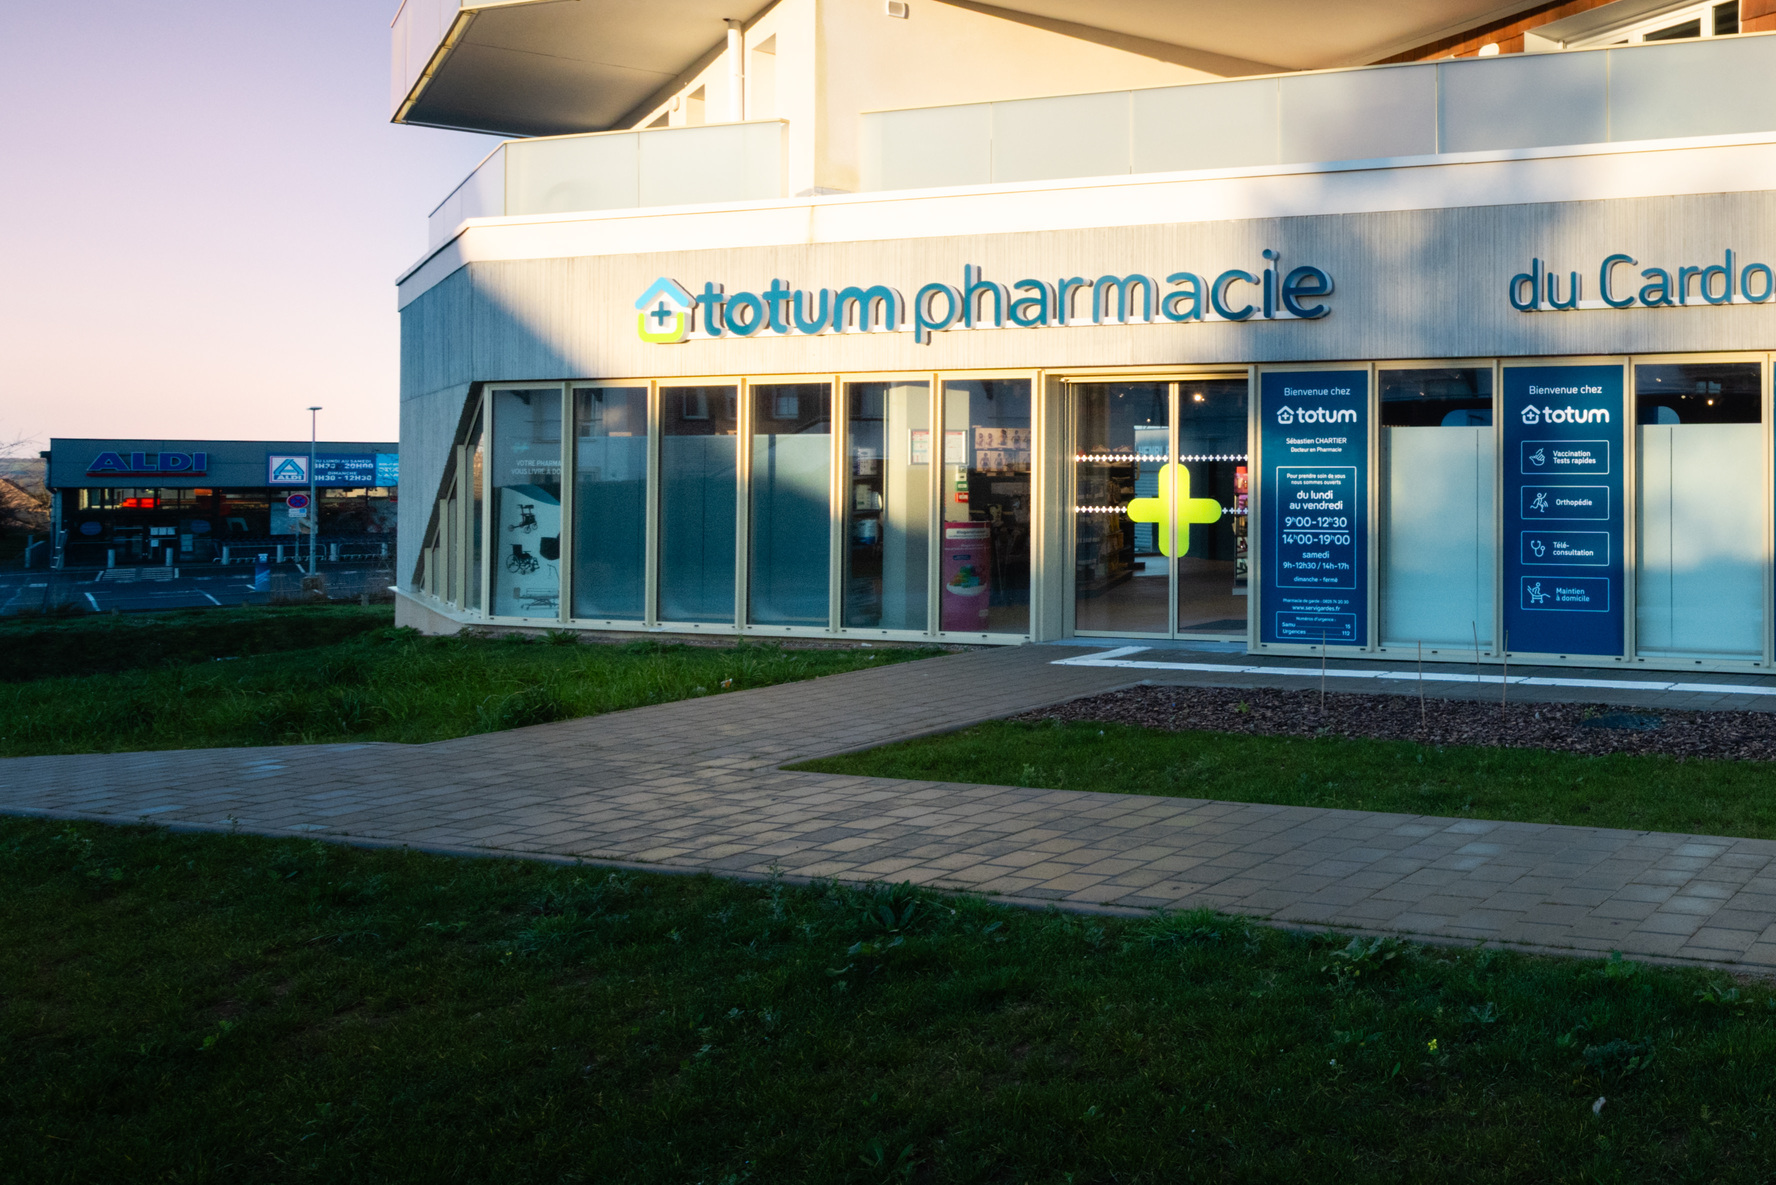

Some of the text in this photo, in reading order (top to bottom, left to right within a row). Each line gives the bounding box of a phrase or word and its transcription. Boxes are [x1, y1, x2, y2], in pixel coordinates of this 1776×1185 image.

[1509, 248, 1776, 311] du Cardo
[696, 249, 1334, 346] totum pharmacie
[1284, 386, 1351, 396] Bienvenue chez
[1529, 384, 1603, 395] Bienvenue chez
[1296, 406, 1357, 424] totum
[1542, 405, 1610, 424] totum
[1285, 437, 1315, 445] Sébastien
[87, 451, 207, 472] ALDI
[1571, 457, 1596, 465] rapides
[1298, 472, 1317, 480] prendre
[1296, 489, 1334, 500] du lundi
[1289, 500, 1343, 510] au vendredi
[1555, 498, 1593, 507] Orthopédie
[1552, 541, 1570, 549] Télé-
[1302, 550, 1330, 559] samedi
[1283, 561, 1317, 570] 9h-12h30
[1322, 562, 1350, 570] 14h-17h
[1555, 587, 1585, 595] Maintien
[1292, 604, 1341, 612] www.servigardes.fr
